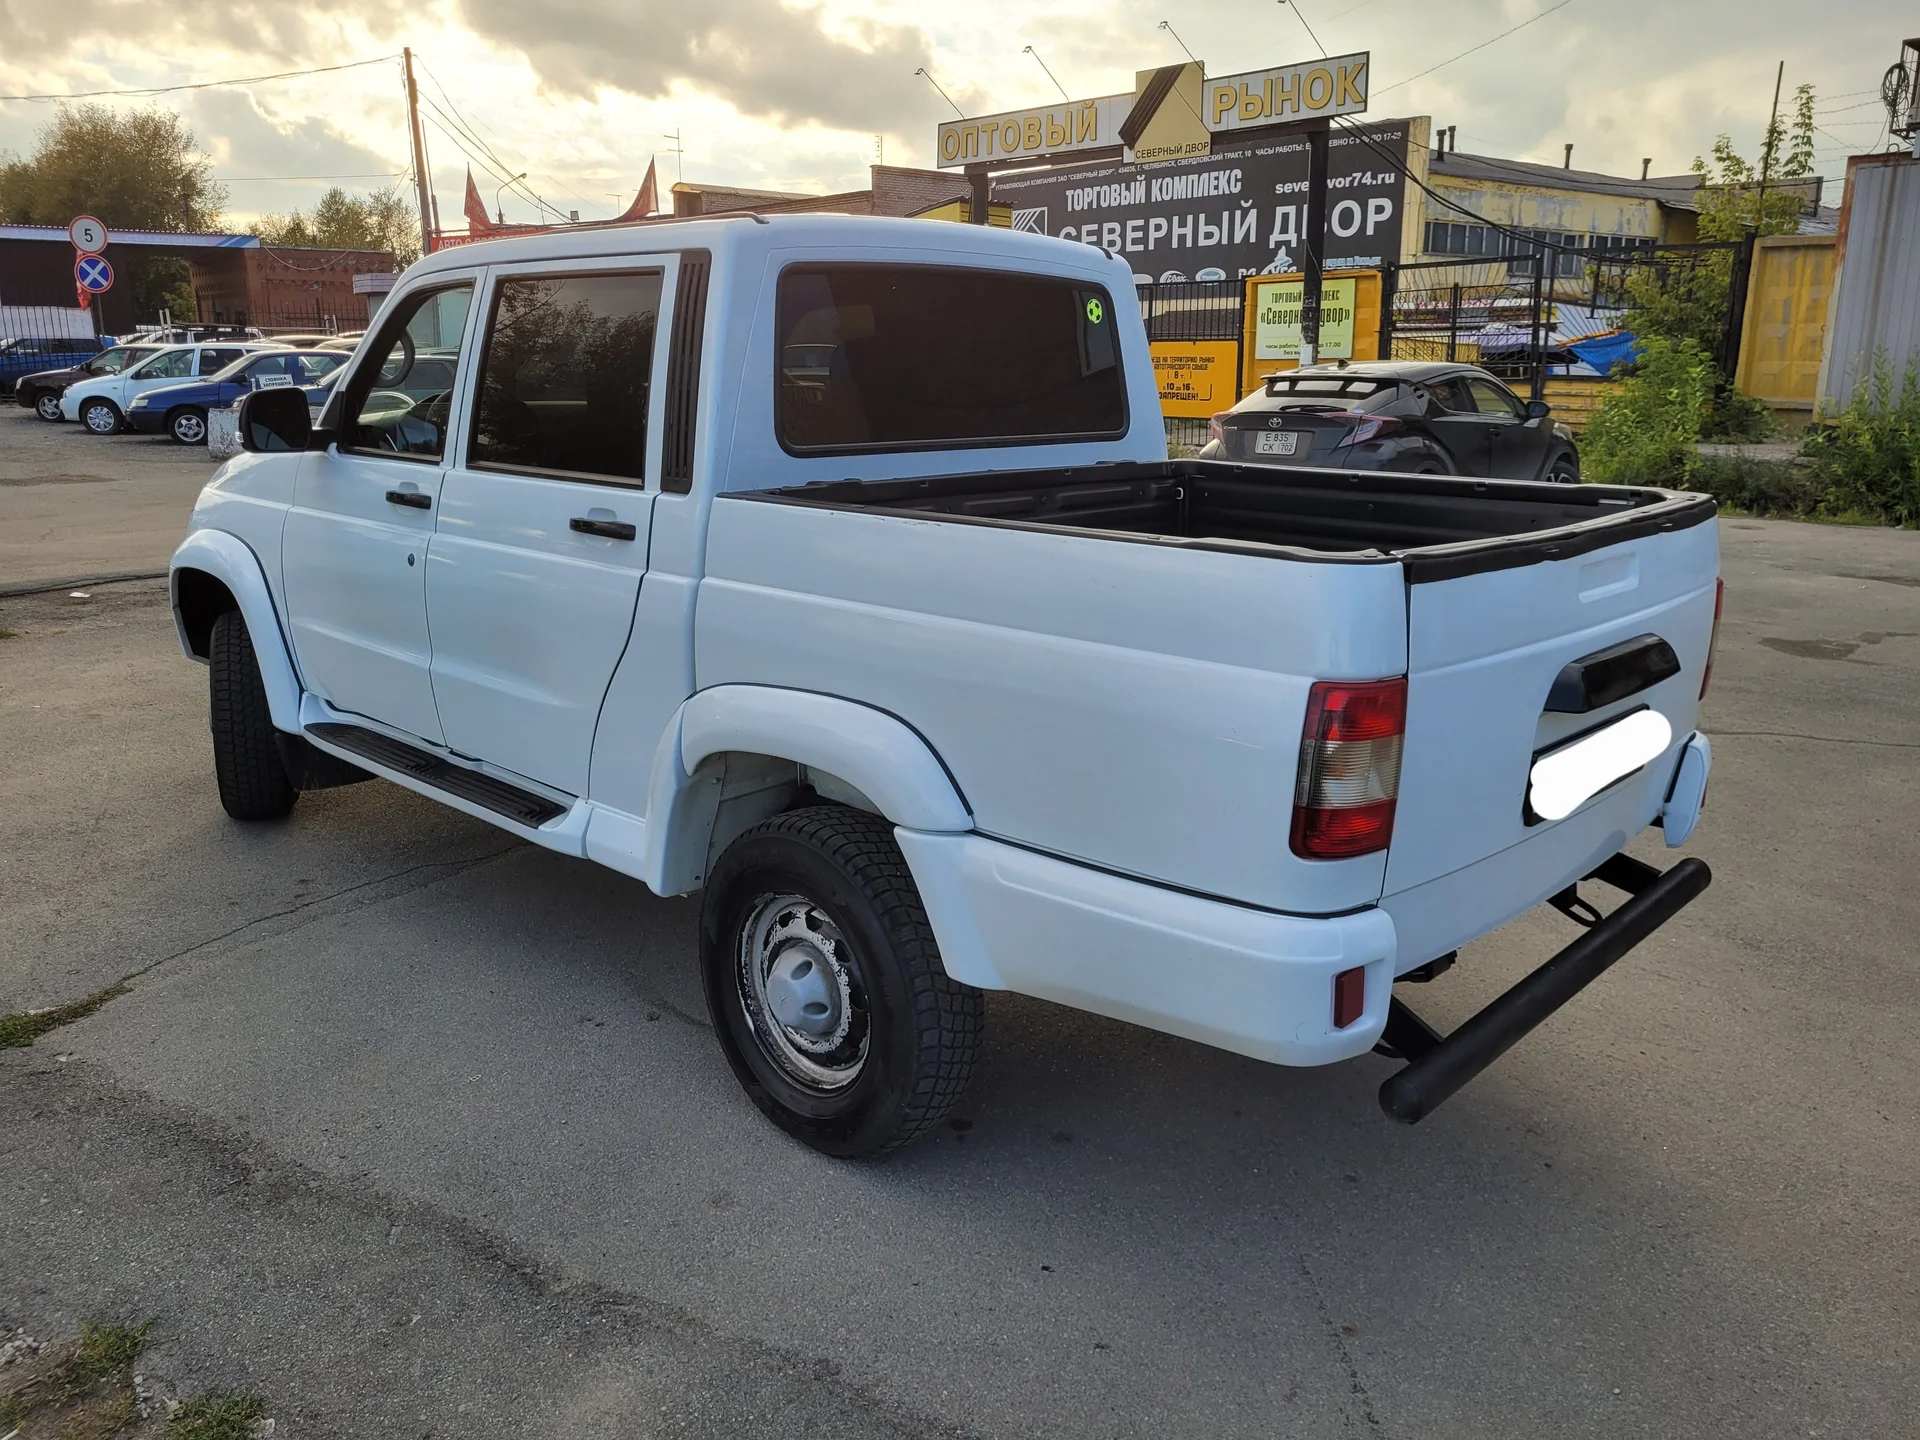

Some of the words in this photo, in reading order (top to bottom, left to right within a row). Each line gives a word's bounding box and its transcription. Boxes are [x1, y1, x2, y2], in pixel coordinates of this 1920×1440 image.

[941, 100, 1097, 160] ОПТОВЫЙ
[1213, 62, 1366, 124] РЫНОК
[1135, 143, 1183, 159] СЕВЕРНЫЙ
[1185, 141, 1209, 154] ДВОР
[995, 180, 1030, 191] УПРАВЛЯЮЩАЯ
[1031, 176, 1057, 186] КОМПАНИЯ
[1177, 153, 1223, 166] СВЕРДЛОВСКИЙ
[1255, 147, 1274, 156] ЧАСЫ
[1066, 175, 1146, 212] ТОРГОВЫЙ
[1151, 168, 1242, 203] КОМПЛЕКС
[1275, 171, 1395, 194] sevevor74.ru
[84, 228, 94, 243] 5
[1271, 290, 1302, 304] ТОРГОВЫЙ
[1260, 307, 1304, 328] «Северн
[1166, 382, 1175, 391] 10
[1182, 383, 1191, 391] 16
[1158, 391, 1199, 401] ЗАПРЕЩЕН!
[1273, 433, 1289, 442] 835
[1262, 443, 1275, 452] СК
[1281, 444, 1294, 452] 702
